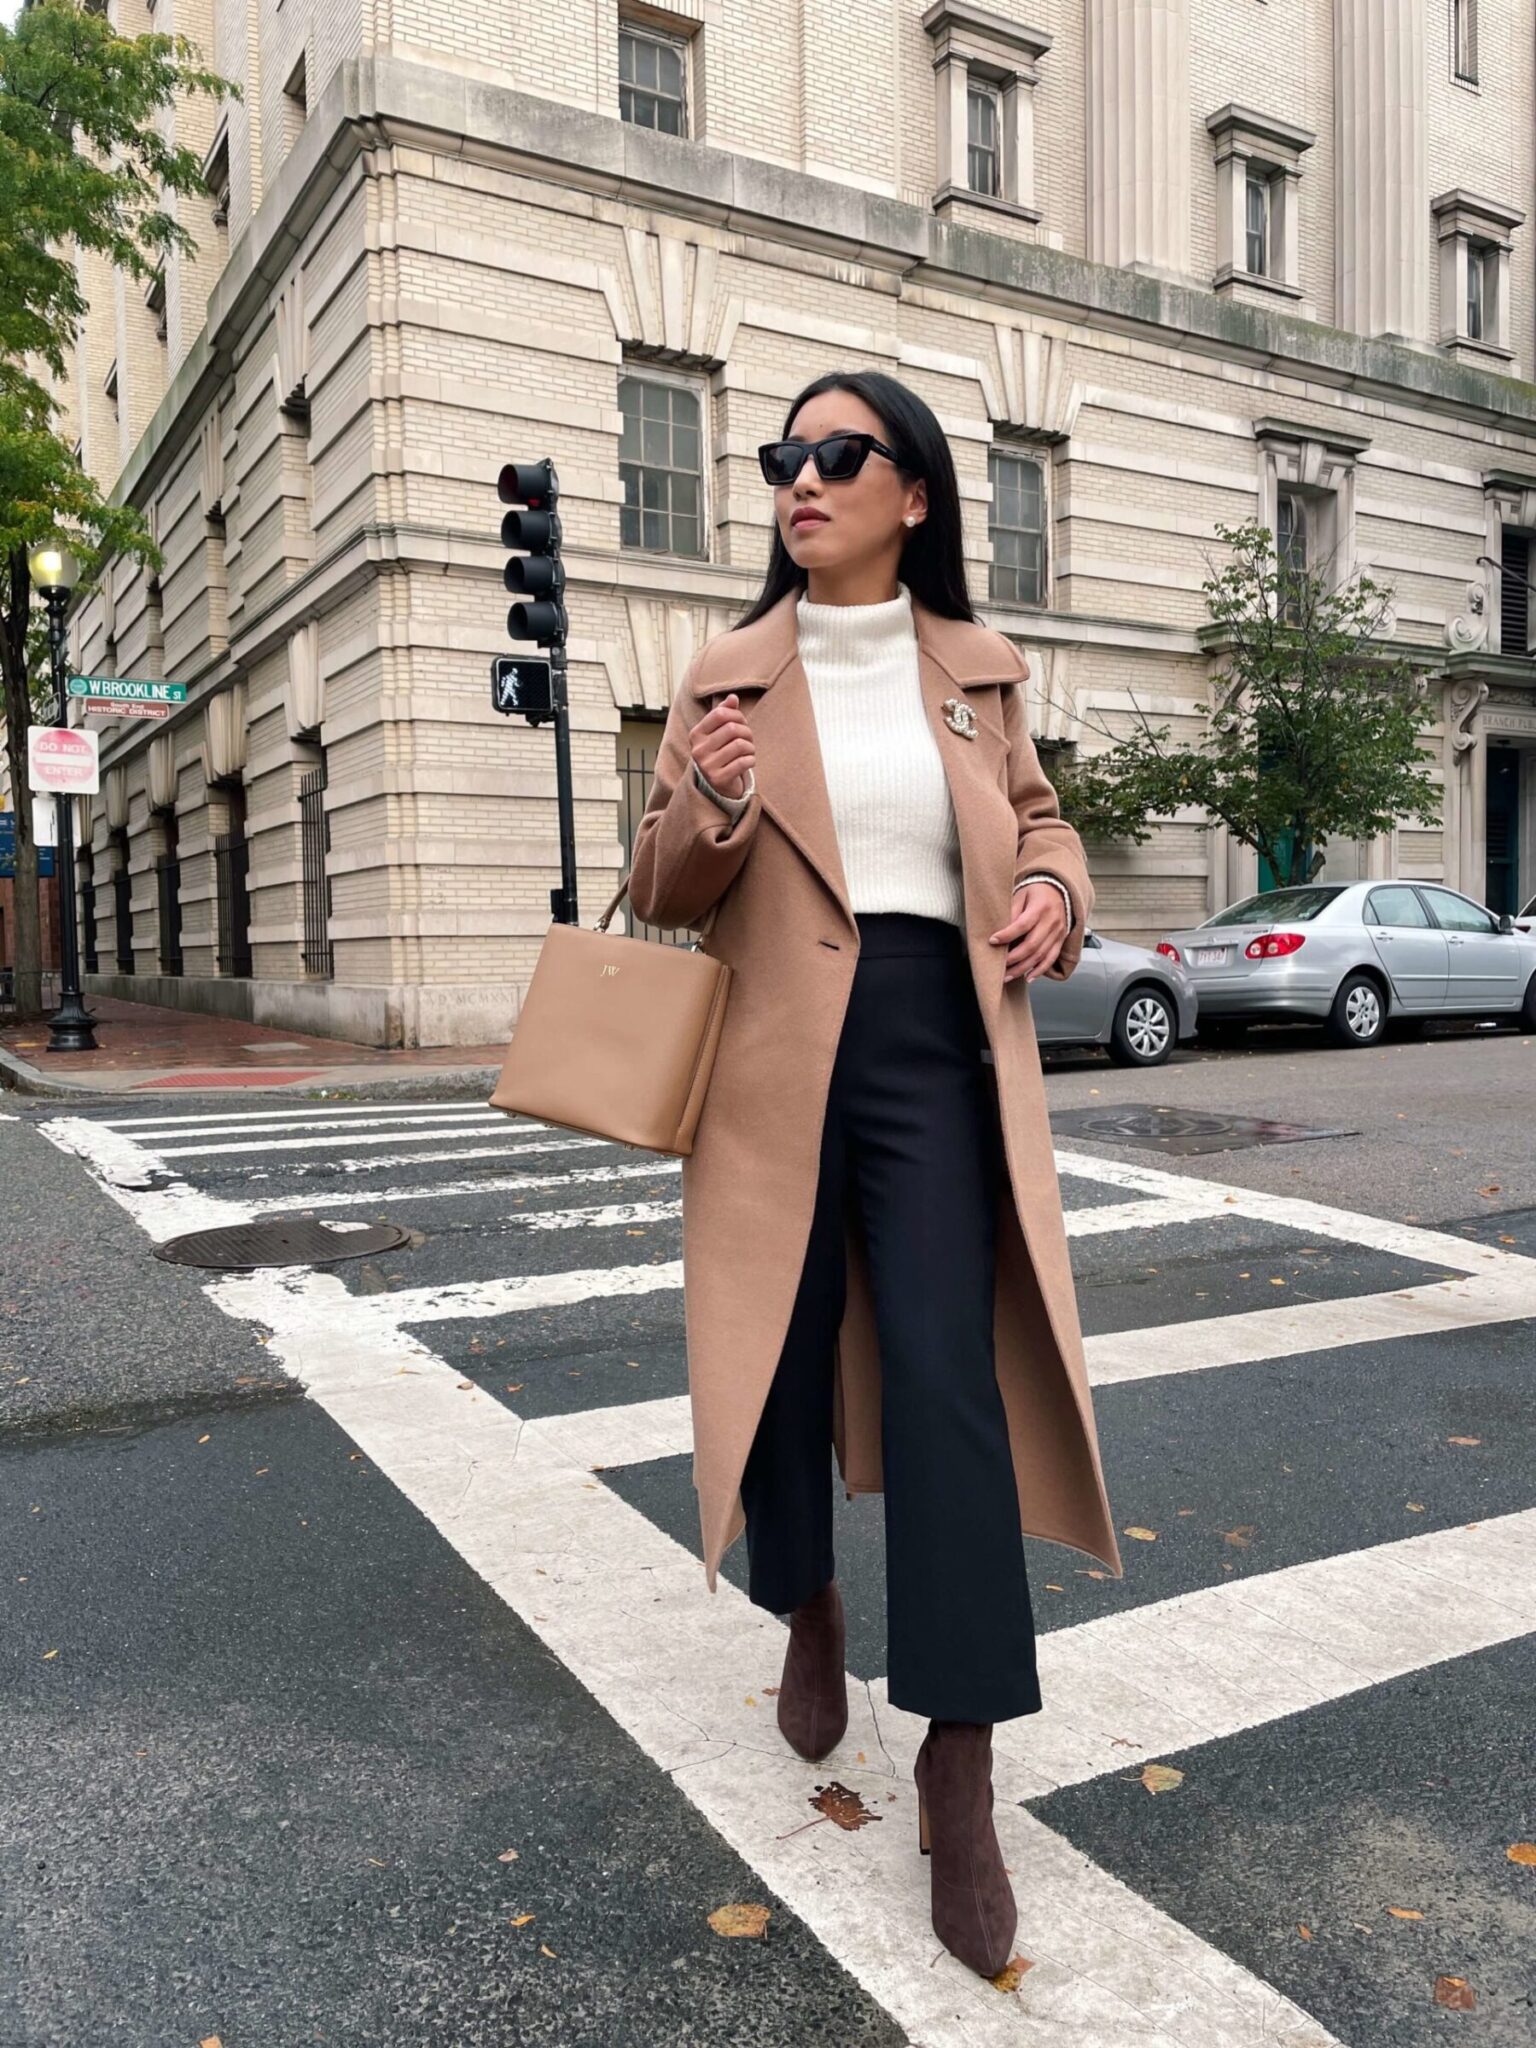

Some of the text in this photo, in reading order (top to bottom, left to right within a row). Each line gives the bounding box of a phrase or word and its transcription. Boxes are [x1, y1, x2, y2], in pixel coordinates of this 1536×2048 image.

[89, 680, 101, 695] W
[102, 681, 171, 699] BROOKLINE
[173, 691, 182, 700] ST
[88, 705, 166, 717] HISTORIC DISTRICT
[40, 741, 89, 754] DO NOT
[45, 766, 83, 777] ENTER
